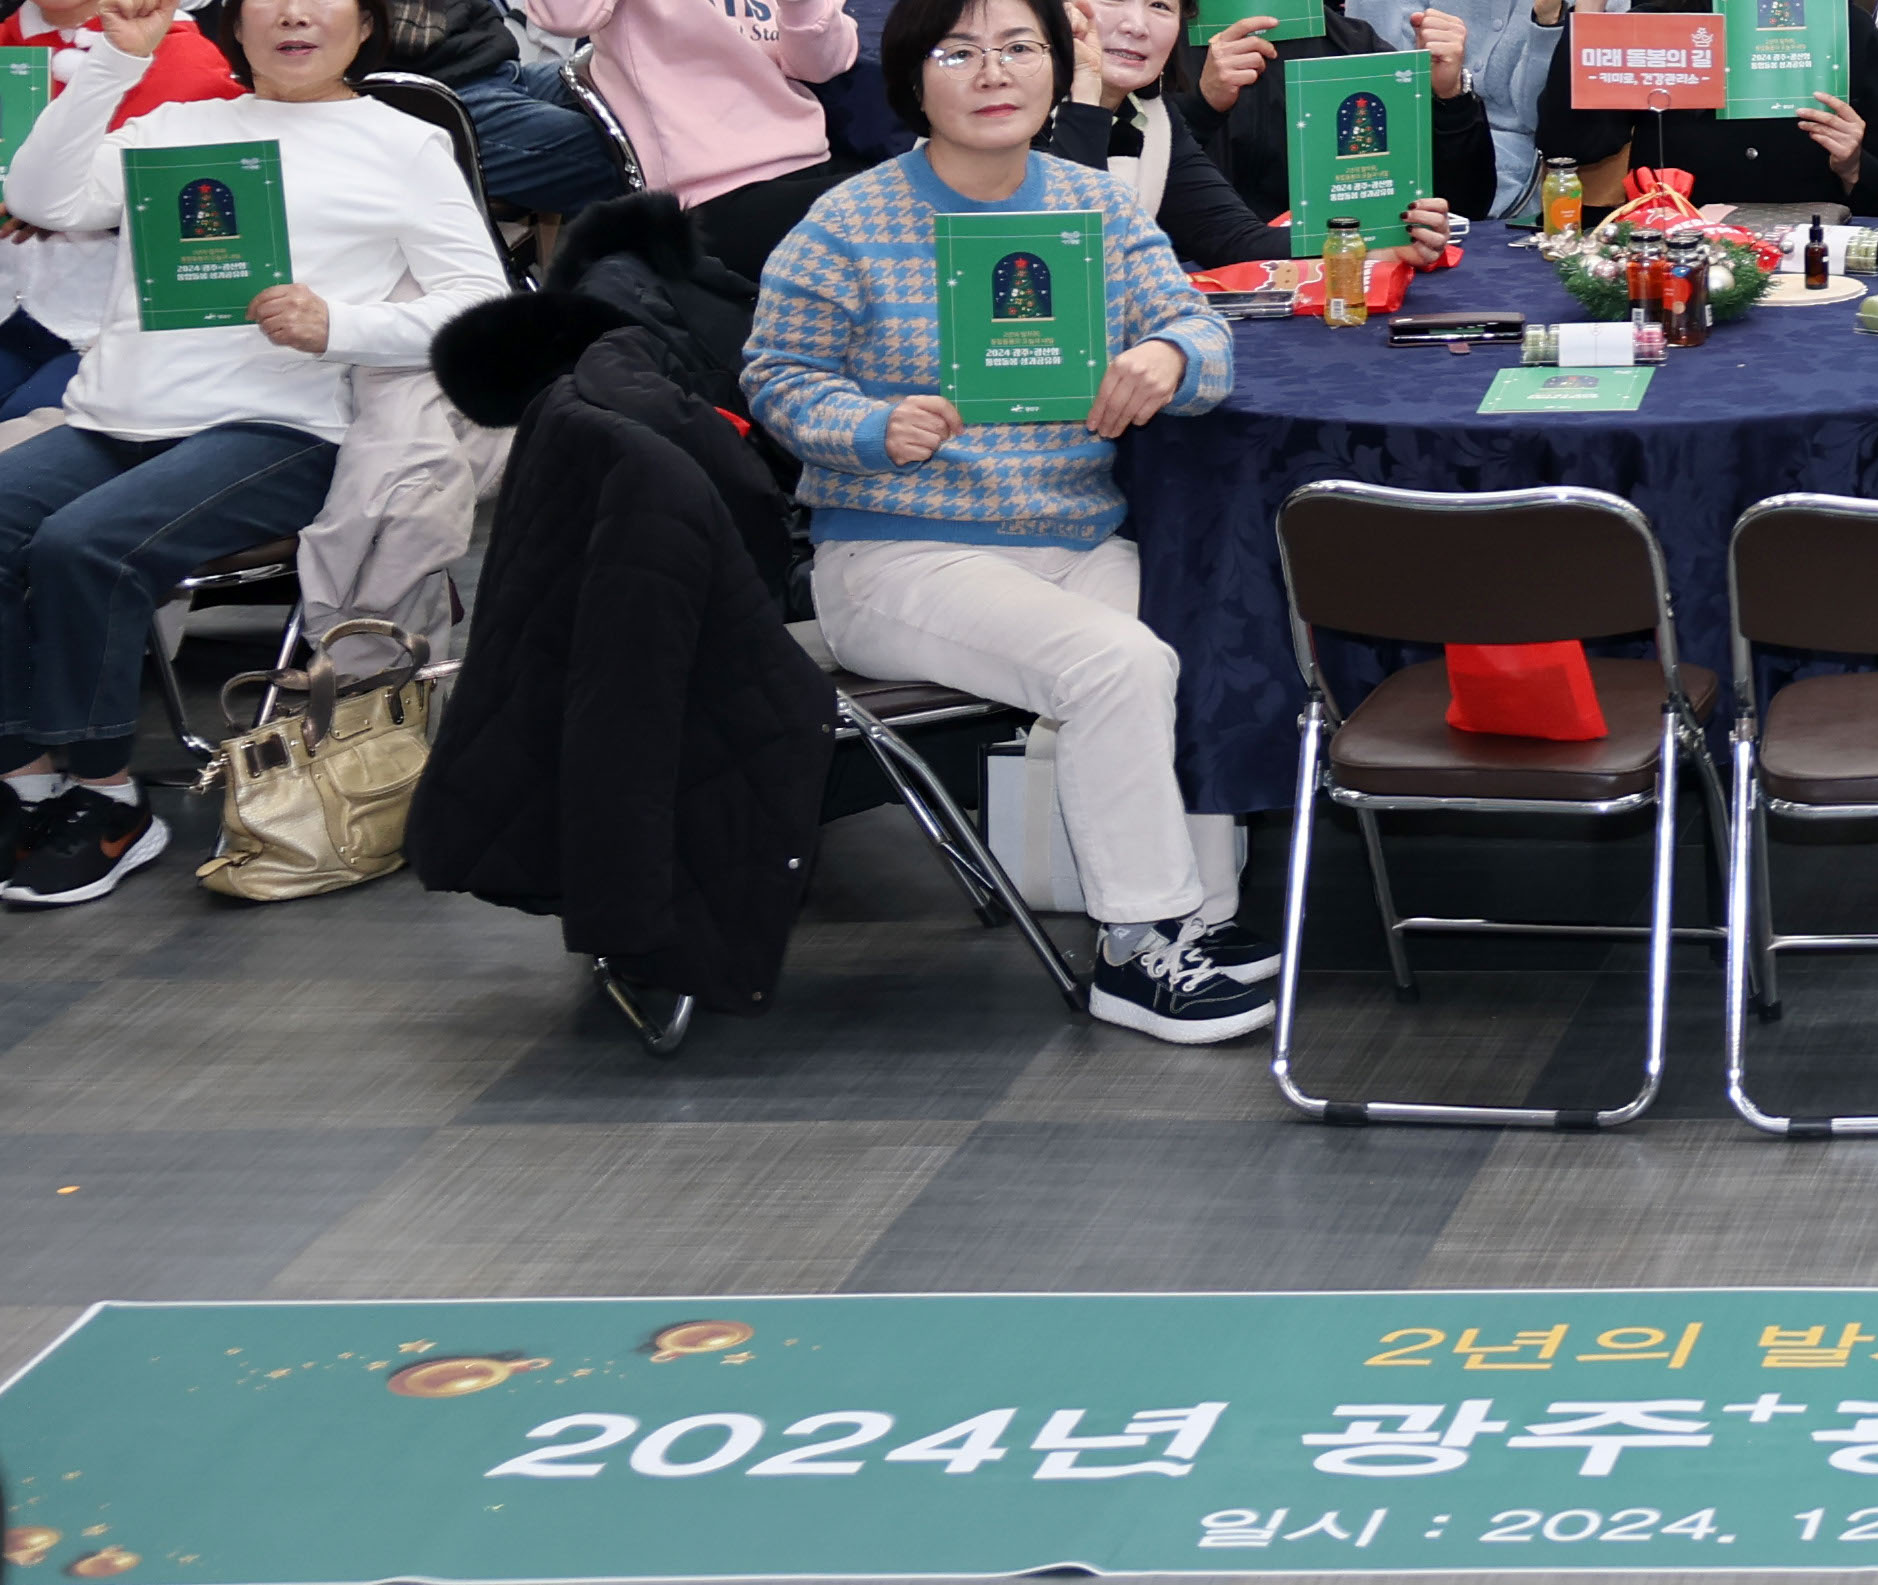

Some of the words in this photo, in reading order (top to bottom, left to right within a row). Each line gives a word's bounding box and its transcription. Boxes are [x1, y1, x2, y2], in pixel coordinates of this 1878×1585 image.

[1581, 48, 1622, 68] 미래
[1626, 48, 1687, 68] 돌봄의
[1691, 48, 1712, 68] 길
[1641, 72, 1700, 86] 건강관리소
[986, 348, 1011, 357] 2024
[1364, 1323, 1706, 1371] 2년의
[486, 1400, 1229, 1481] 2024년
[1193, 1507, 1386, 1548] 일시
[1479, 1507, 1737, 1545] 2024.
